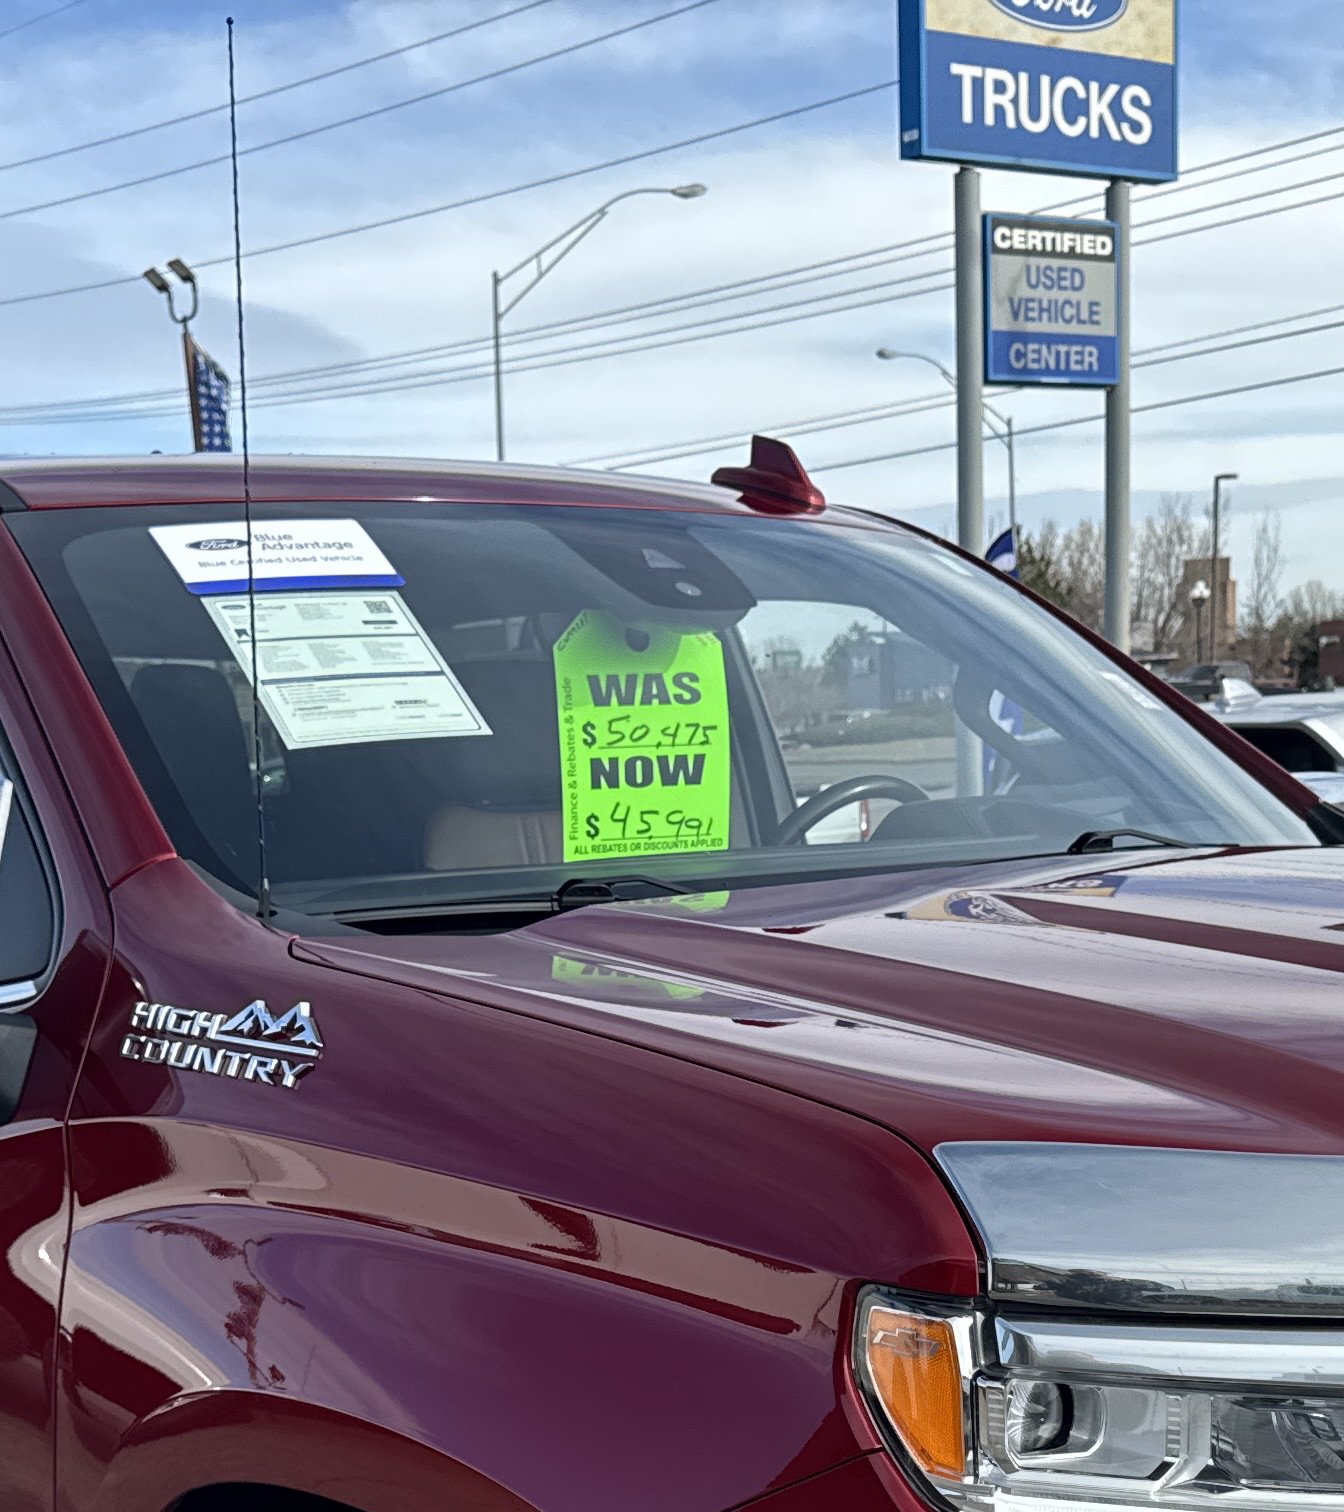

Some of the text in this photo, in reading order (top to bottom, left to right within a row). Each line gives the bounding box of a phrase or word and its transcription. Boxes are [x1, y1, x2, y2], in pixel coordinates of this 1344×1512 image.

[950, 62, 1153, 145] TRUCKS
[994, 226, 1113, 256] CERTIFIED
[1026, 264, 1086, 291] USED
[1008, 297, 1102, 326] VEHICLE
[1009, 342, 1099, 371] CENTER
[199, 539, 239, 550] Ford
[254, 533, 293, 542] Blue
[262, 540, 354, 551] Advantage
[562, 678, 573, 713] Trade
[586, 672, 702, 708] WAS
[567, 725, 577, 778] Rebates
[590, 753, 706, 790] NOW
[568, 792, 579, 841] Finance
[574, 838, 723, 855] ALL REBATES OR DISCOUNTS APPLIED
[131, 1001, 229, 1040] HIGH
[120, 1033, 315, 1089] COUNTRY
